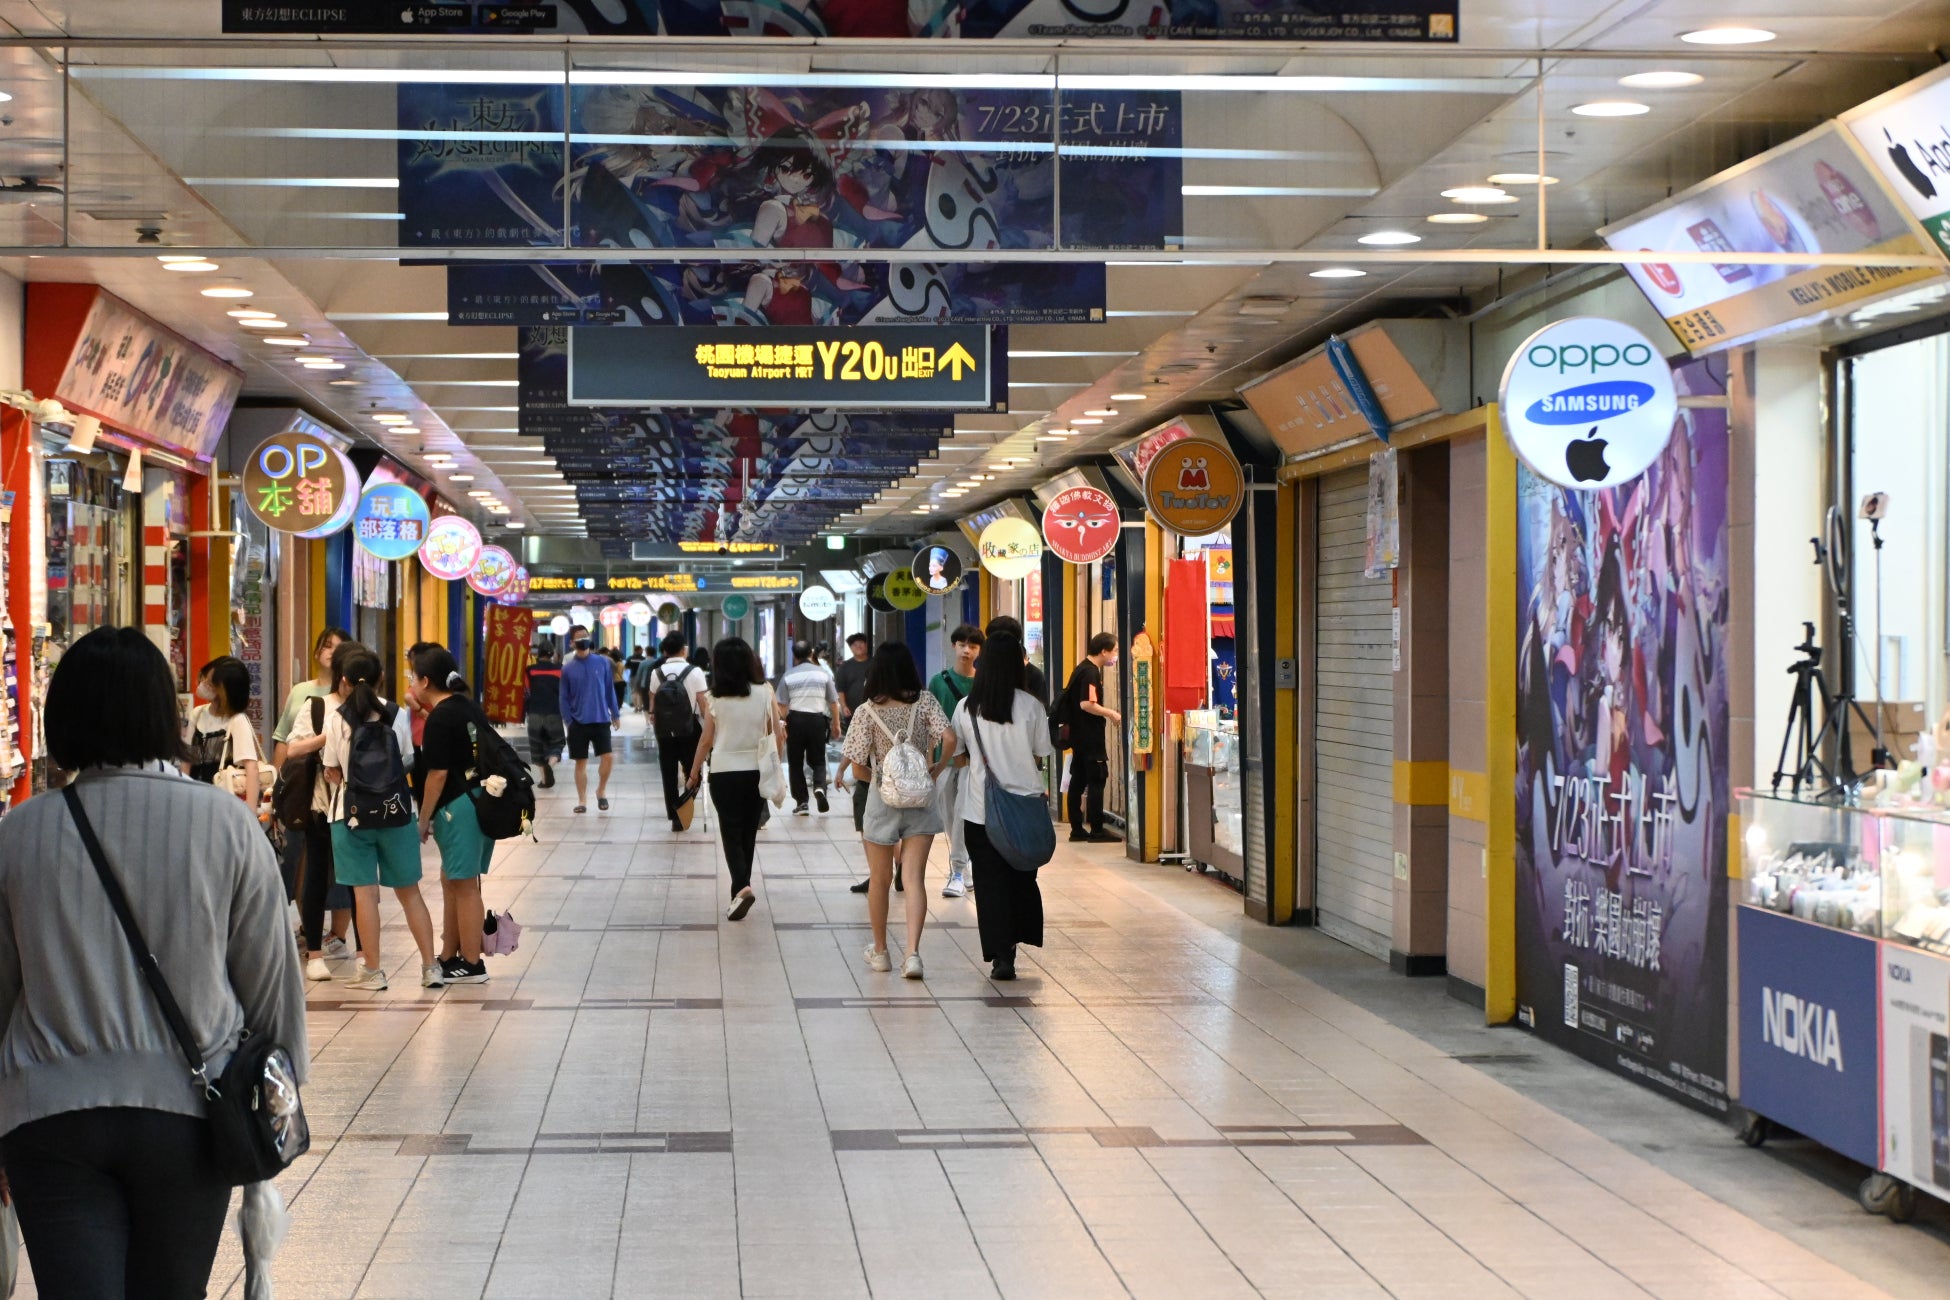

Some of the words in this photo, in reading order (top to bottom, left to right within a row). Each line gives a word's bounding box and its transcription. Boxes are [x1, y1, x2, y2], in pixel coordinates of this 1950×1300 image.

[418, 8, 436, 17] App
[439, 8, 463, 17] Store
[501, 9, 532, 19] Google
[534, 9, 546, 19] Play
[978, 102, 1169, 135] 7/23正式上市
[1824, 266, 1871, 295] MOBILE
[695, 344, 814, 365] 桃園機場捷運
[902, 347, 935, 378] 出口
[707, 366, 747, 379] Taoyuan
[751, 366, 791, 379] Airport
[795, 366, 814, 378] MRT
[1540, 394, 1640, 412] SAMSUNG
[259, 443, 327, 479] OP
[370, 495, 412, 517] 玩具
[358, 519, 422, 541] 部落格
[1073, 549, 1101, 562] BUDDHIST
[1102, 538, 1113, 554] ART
[1553, 770, 1678, 887] 7/23正式上市
[1888, 963, 1912, 983] NOKIA
[1762, 986, 1844, 1073] NOKIA
